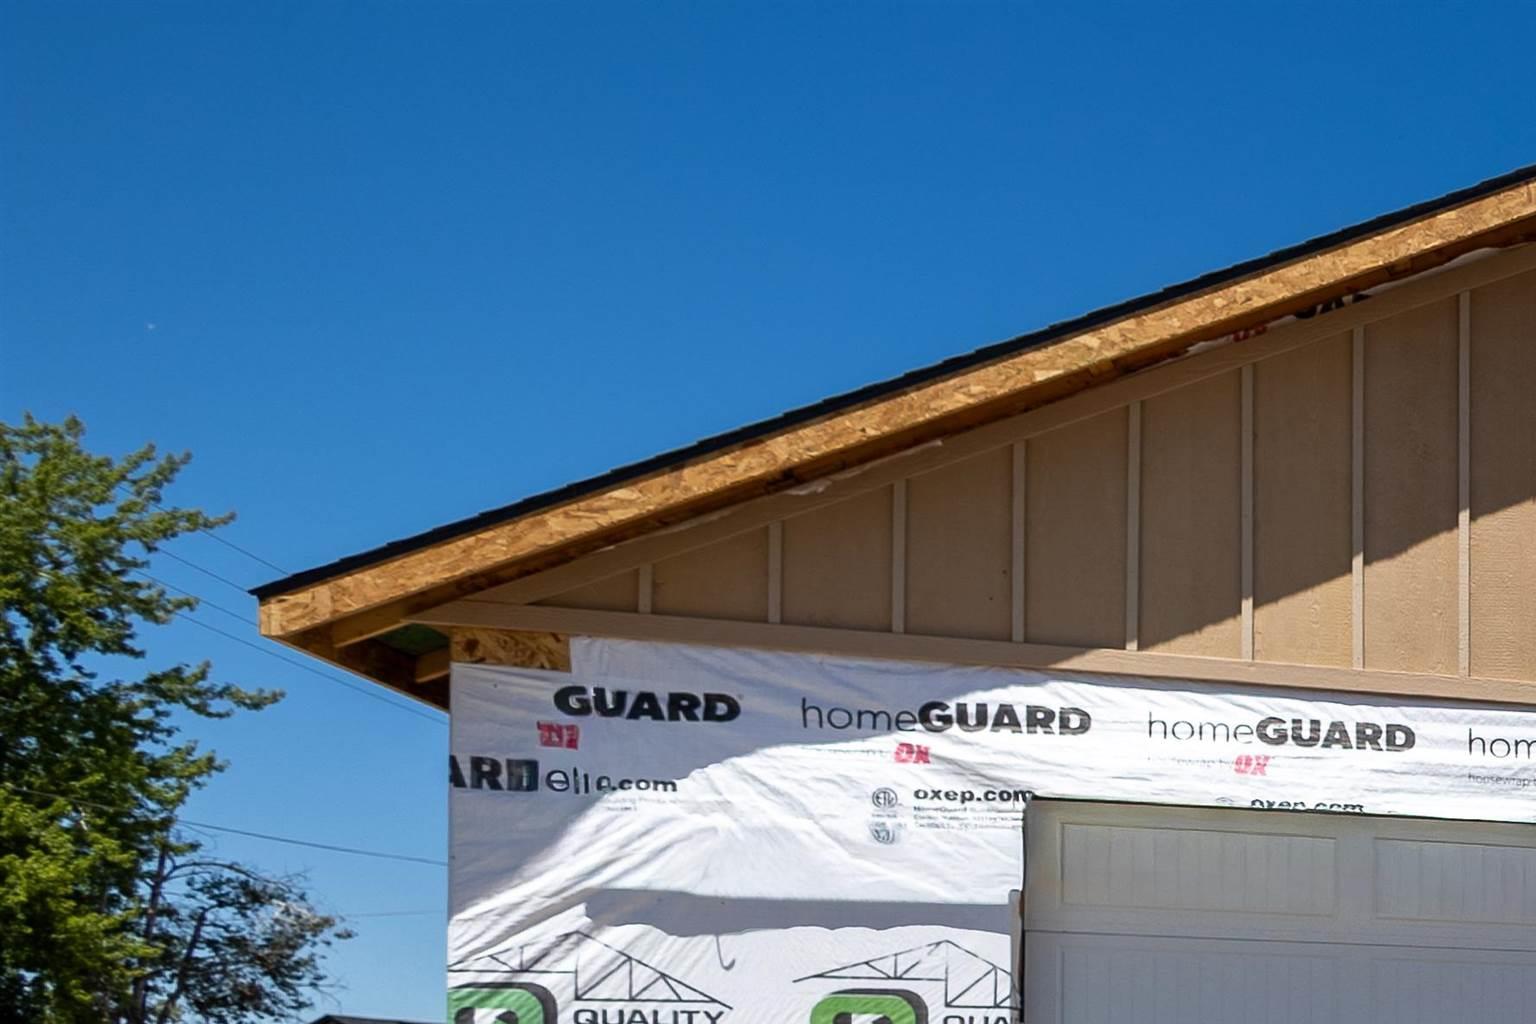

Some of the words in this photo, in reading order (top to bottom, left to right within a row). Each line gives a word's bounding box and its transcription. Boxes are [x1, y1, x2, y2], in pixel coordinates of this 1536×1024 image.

[553, 685, 741, 723] GUARD
[801, 697, 1092, 736] homeGUARD
[1149, 711, 1416, 752] homeGUARD
